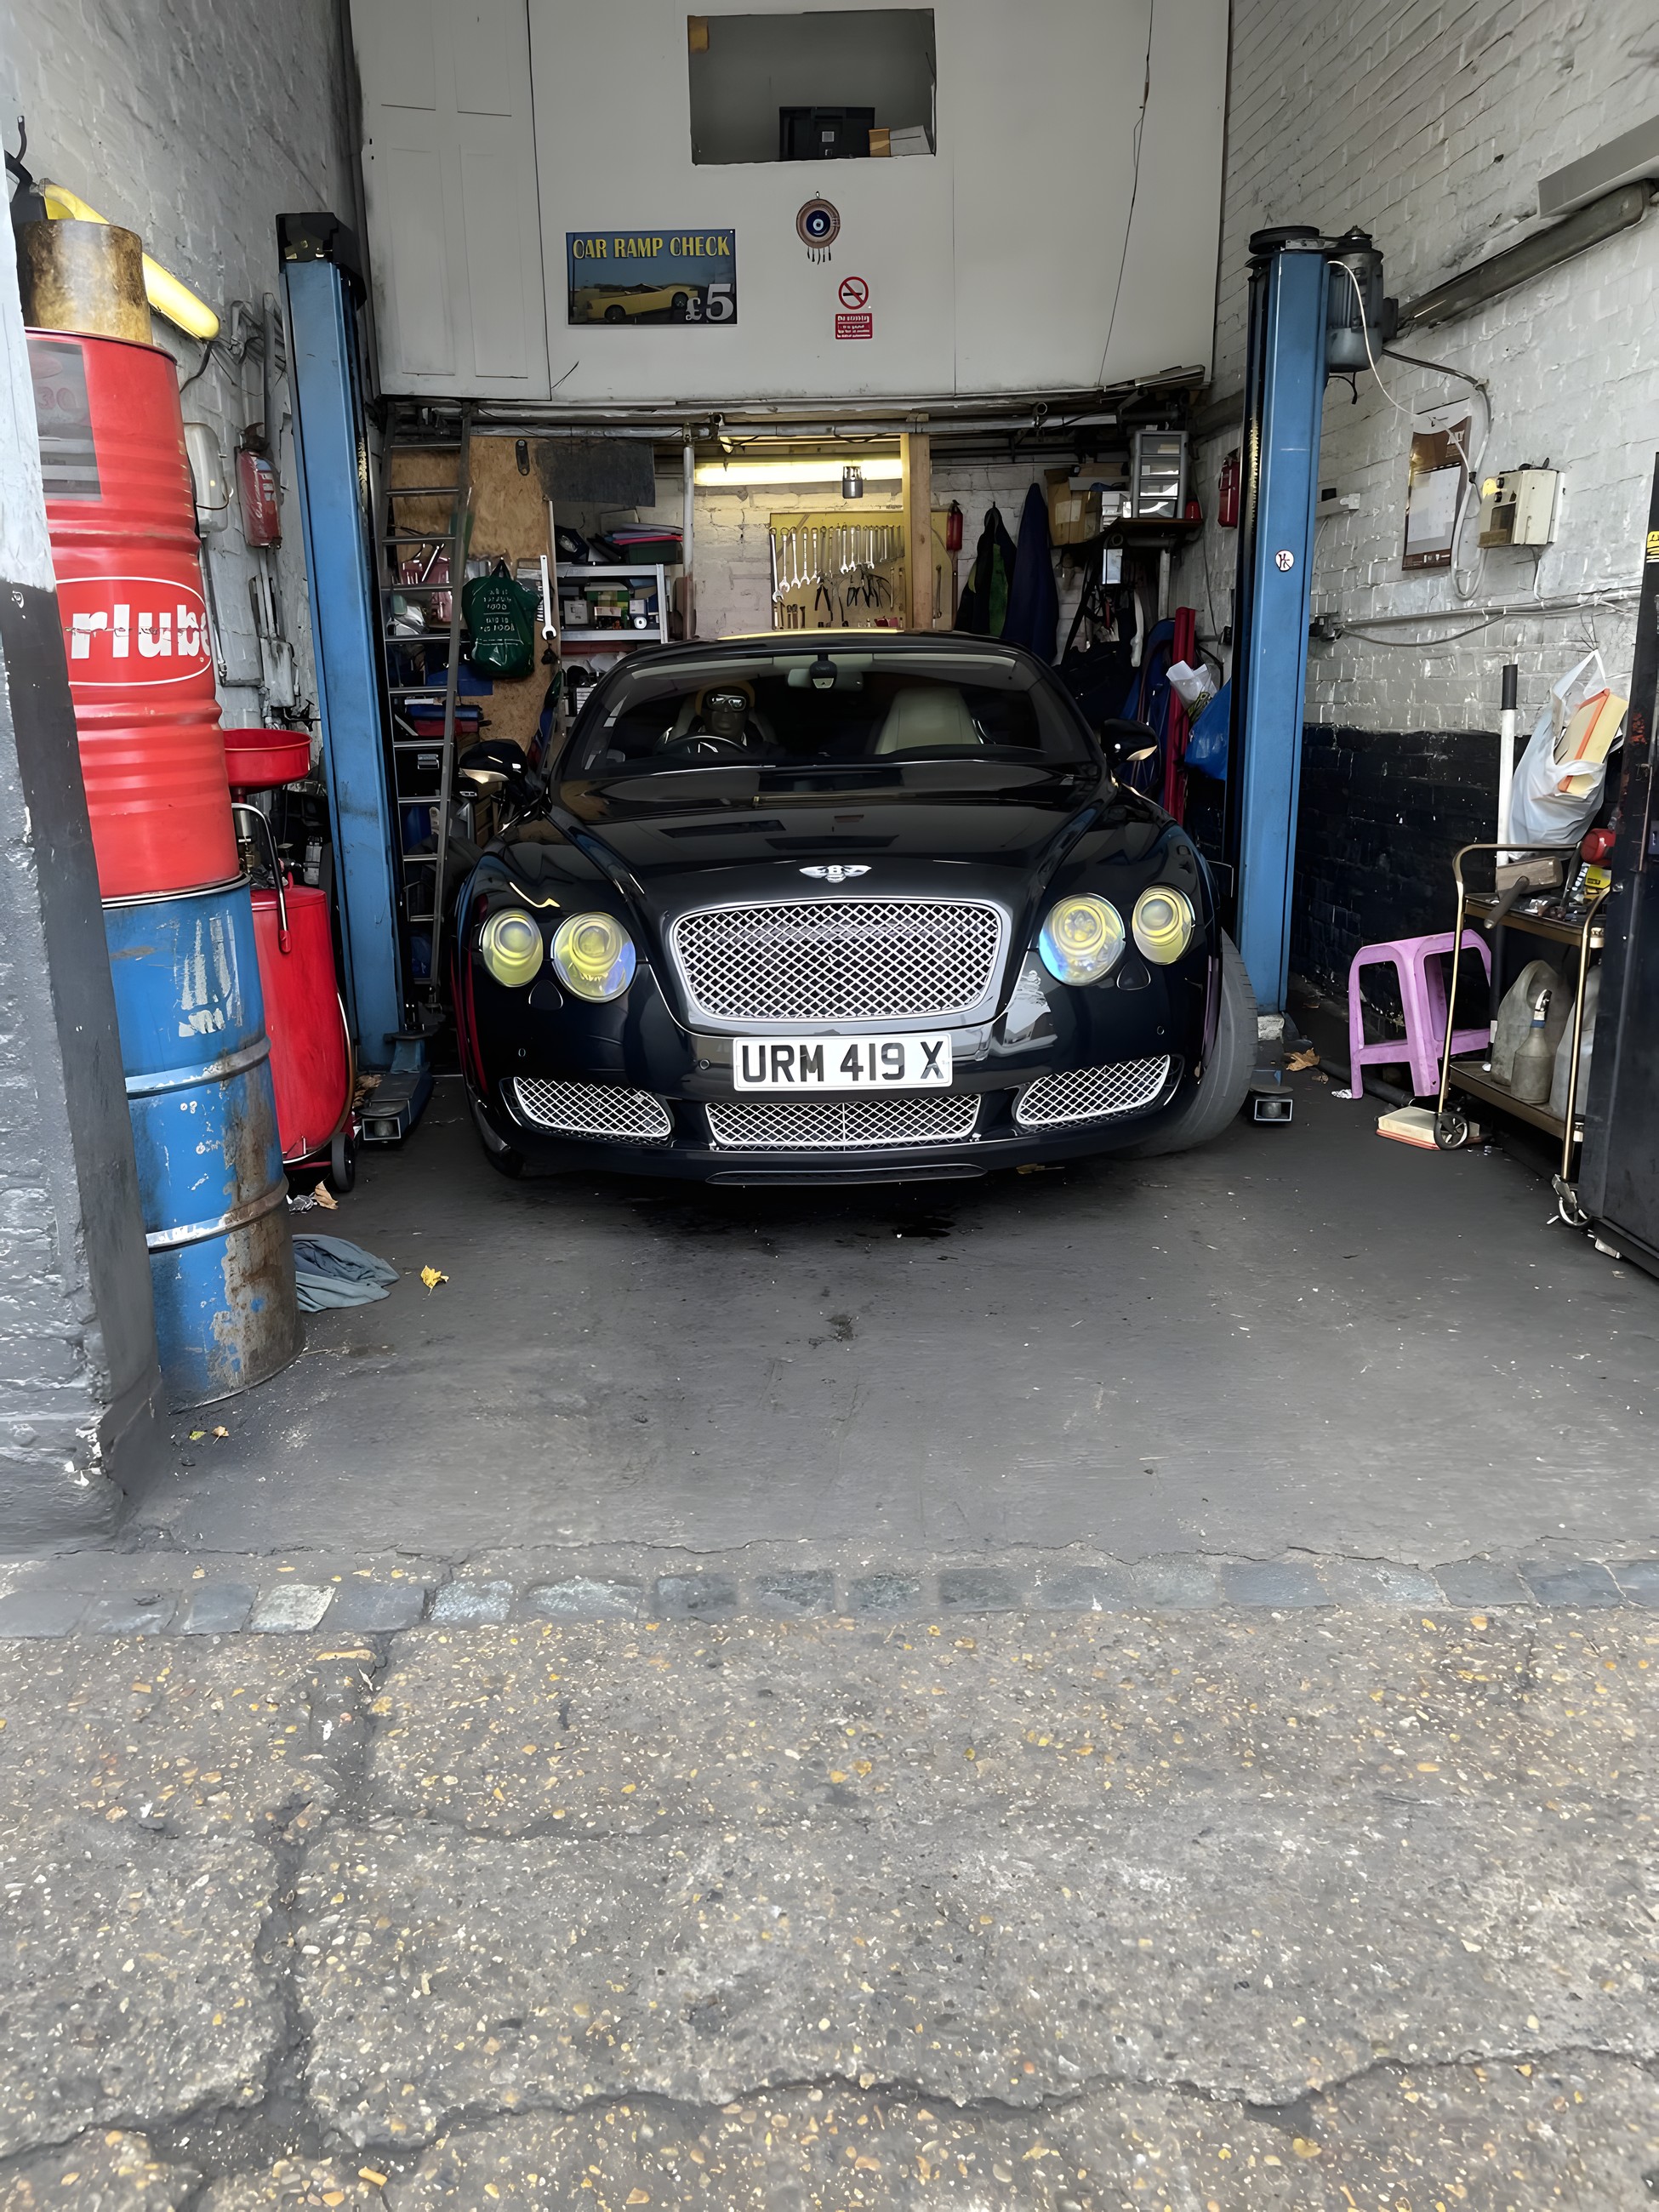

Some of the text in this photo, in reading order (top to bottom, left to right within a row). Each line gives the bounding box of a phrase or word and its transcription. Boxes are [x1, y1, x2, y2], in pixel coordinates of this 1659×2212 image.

[573, 237, 730, 259] CAR RAMP CHECK
[685, 283, 733, 321] £5
[742, 1040, 944, 1083] URM 419 X
